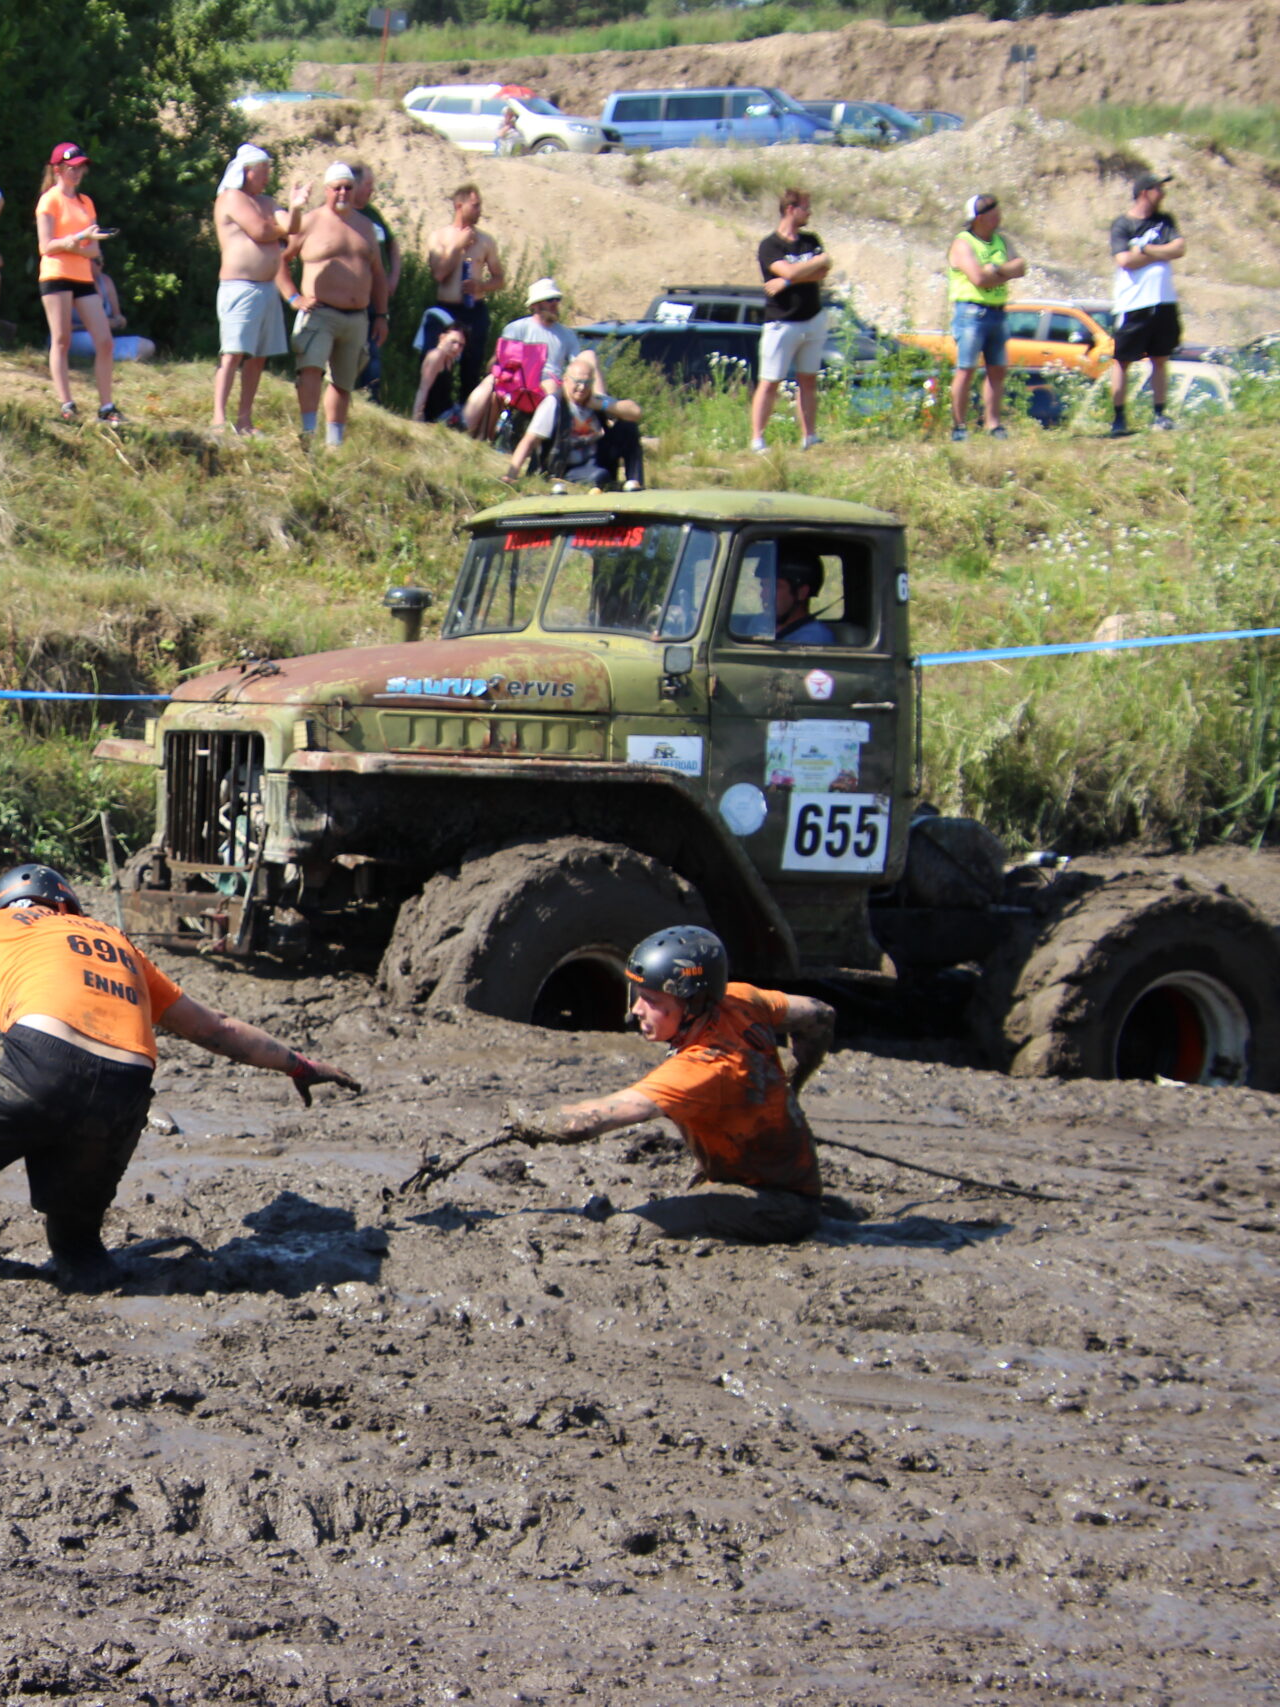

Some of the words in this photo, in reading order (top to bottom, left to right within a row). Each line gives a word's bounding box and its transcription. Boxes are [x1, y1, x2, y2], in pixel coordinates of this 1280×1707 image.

[794, 803, 880, 858] 655
[66, 934, 138, 976] 696
[83, 969, 139, 1006] ENNO
